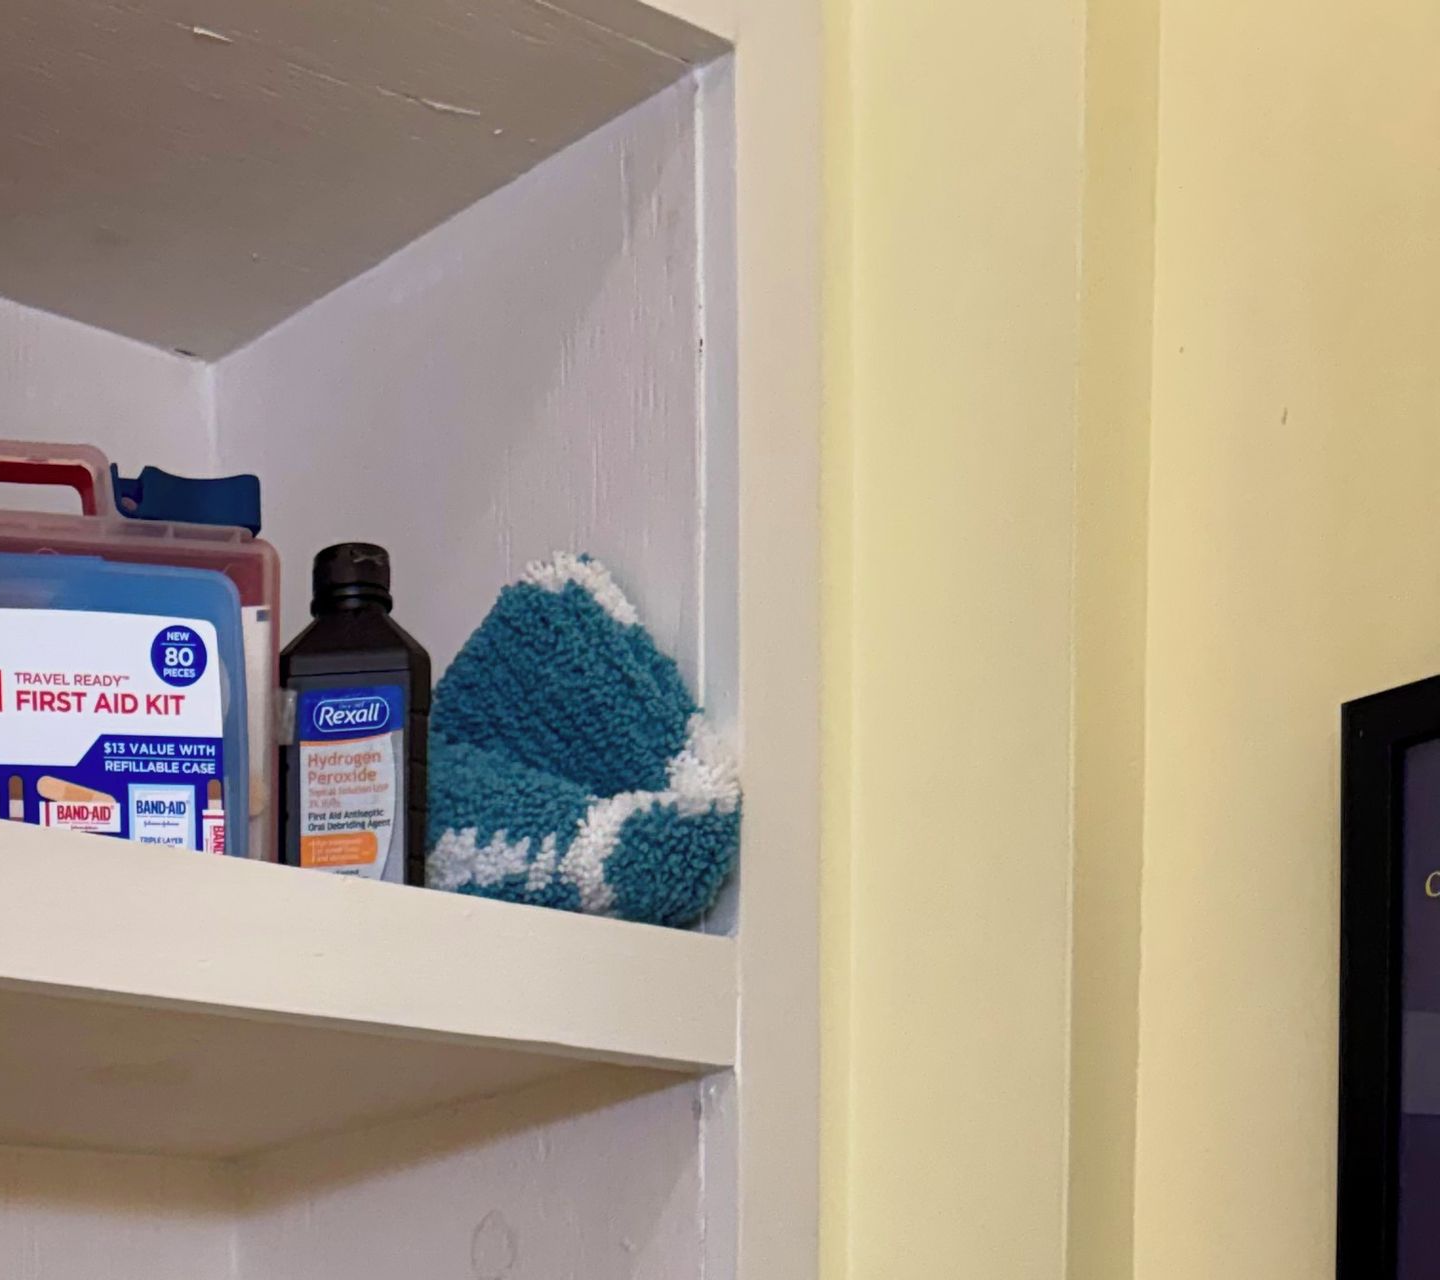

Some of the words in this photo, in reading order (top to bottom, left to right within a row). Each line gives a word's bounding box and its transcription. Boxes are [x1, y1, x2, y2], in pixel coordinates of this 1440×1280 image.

[166, 632, 190, 641] NEW
[164, 648, 194, 667] 80
[14, 672, 71, 686] TRAVEL
[163, 668, 196, 678] PIECES
[15, 690, 87, 713] FIRST
[93, 692, 139, 714] AID
[145, 694, 186, 715] KIT
[318, 703, 380, 727] Rexall
[103, 742, 125, 754] $13
[129, 743, 176, 755] VALUE
[178, 744, 216, 756] WITH
[104, 760, 180, 773] REFILLABLE
[182, 762, 216, 774] CASE
[308, 749, 382, 771] Hydrogen
[308, 767, 377, 785] Peroxide
[56, 804, 112, 821] BAND-AID
[136, 800, 187, 815] BAND-AID
